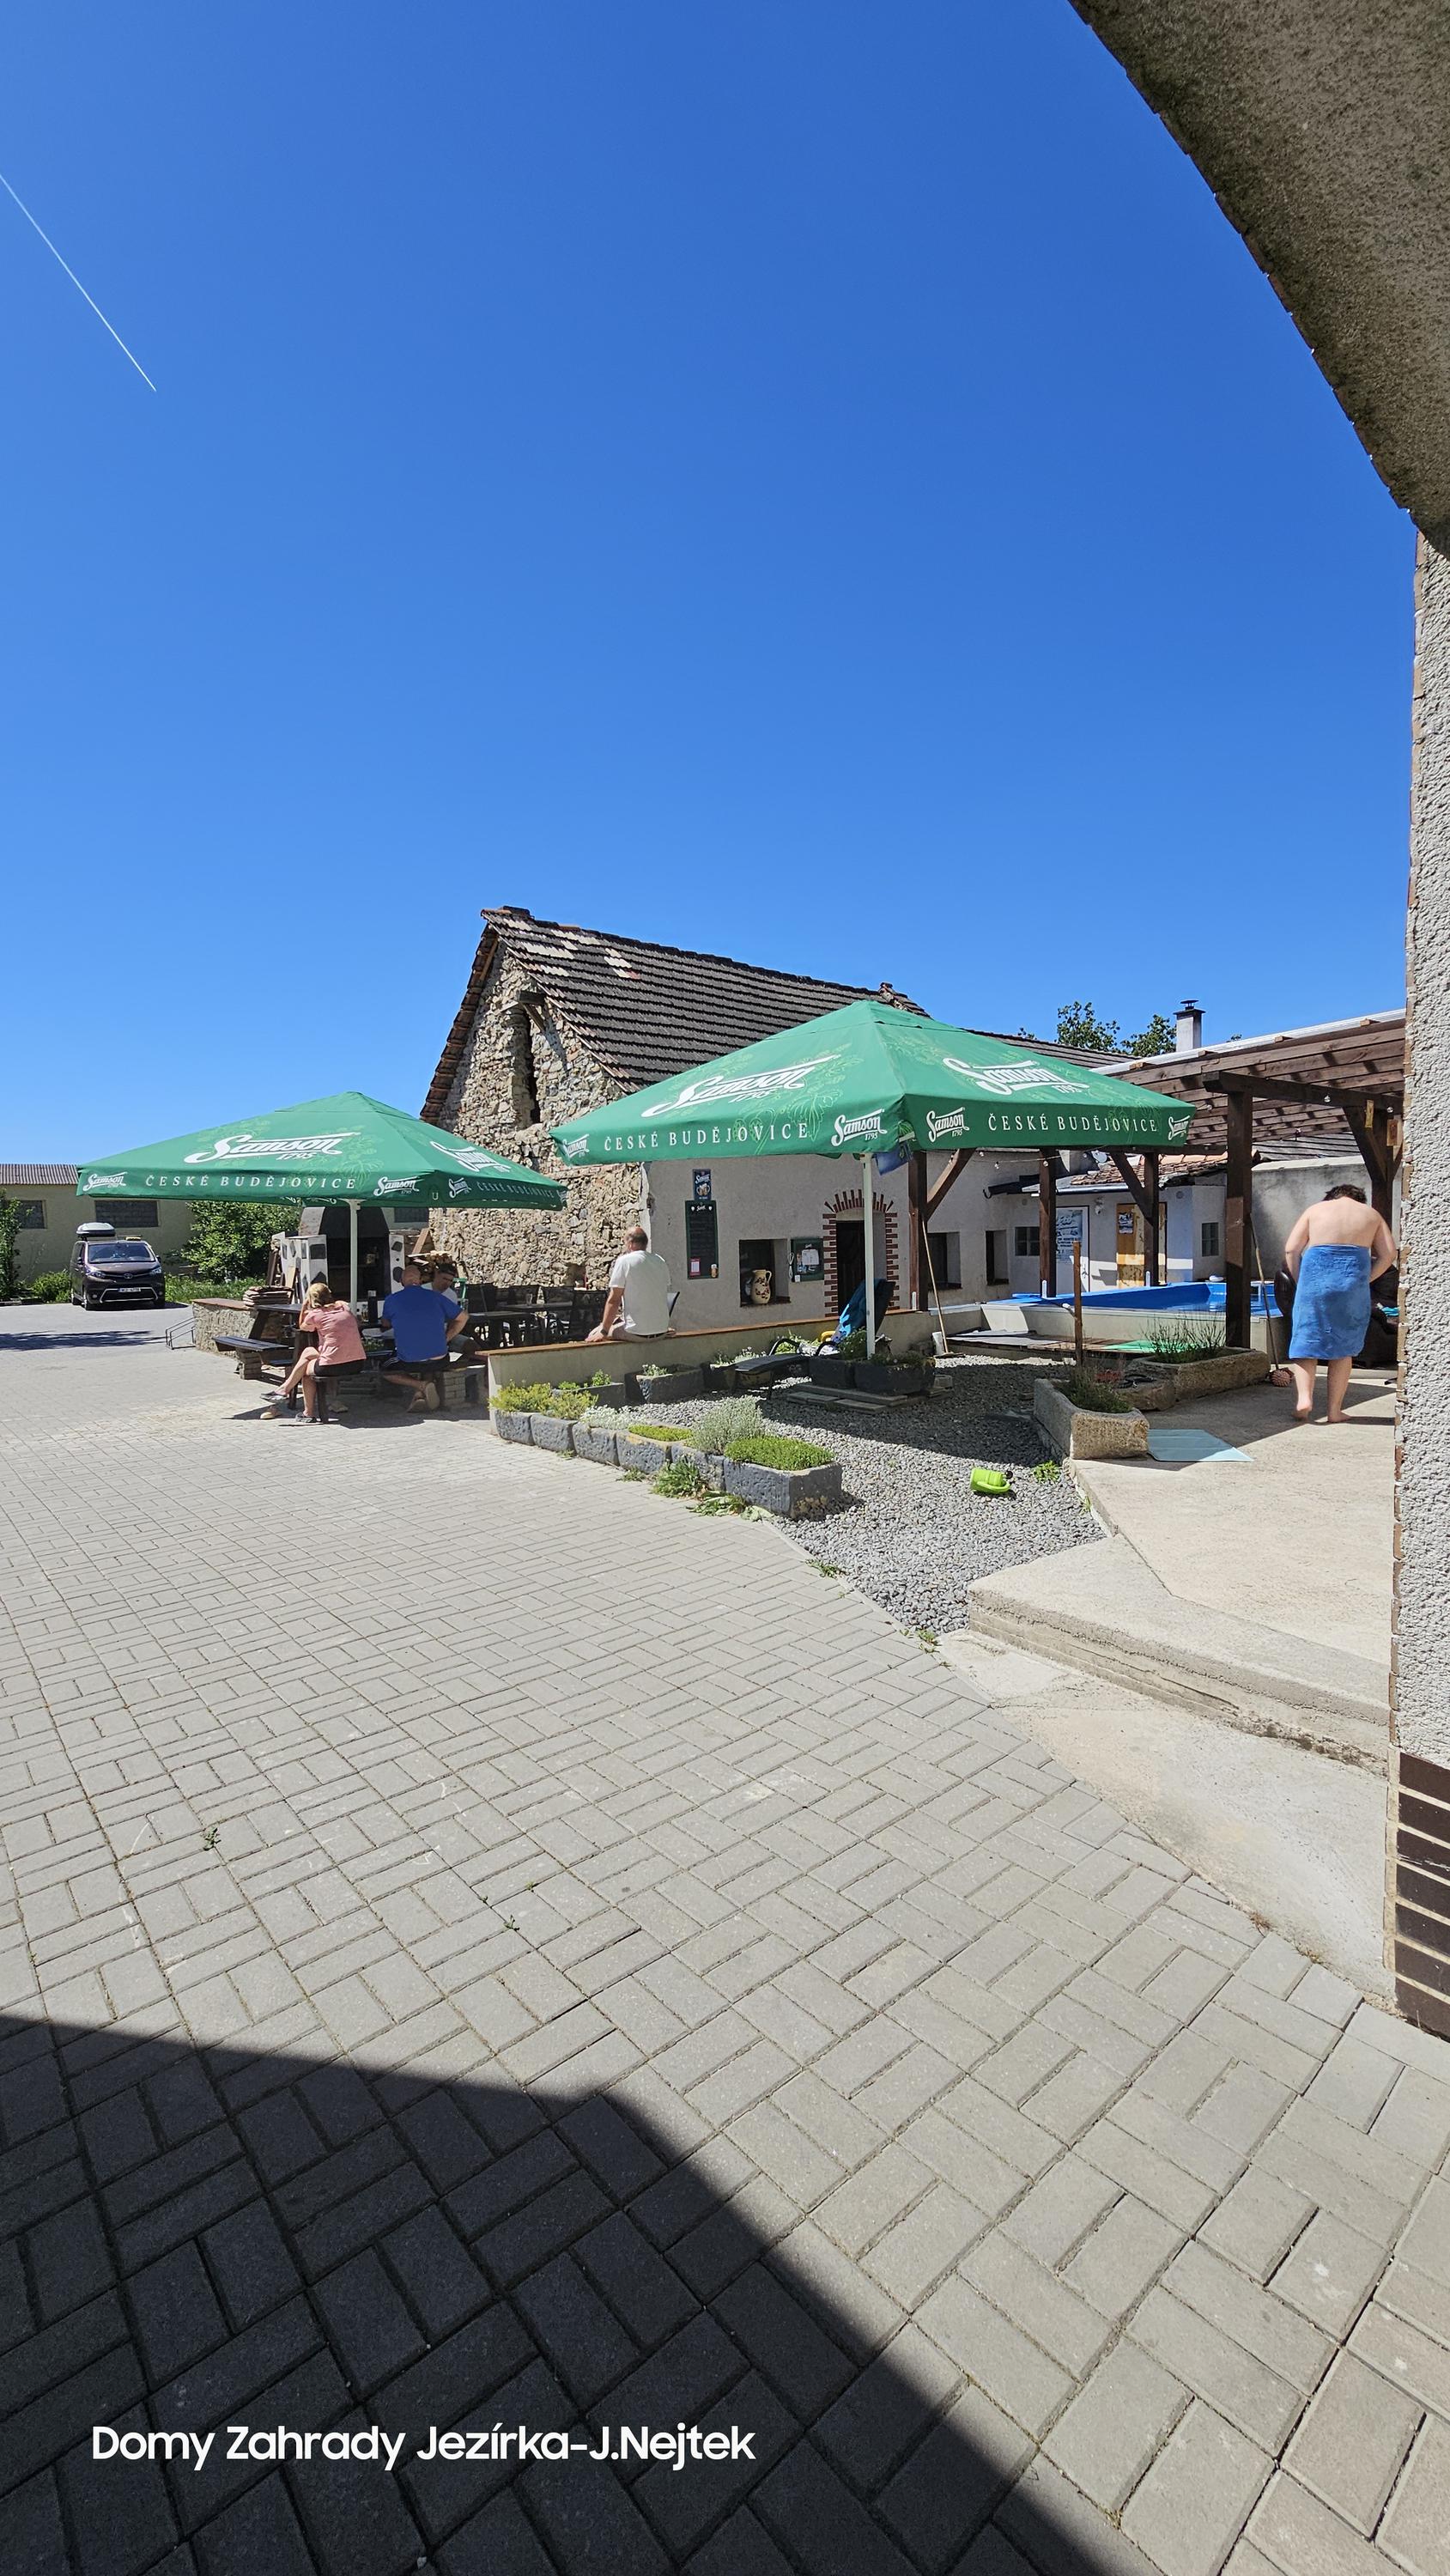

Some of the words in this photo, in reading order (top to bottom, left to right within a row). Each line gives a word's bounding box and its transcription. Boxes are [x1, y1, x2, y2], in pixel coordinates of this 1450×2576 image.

[641, 1054, 841, 1117] Samson
[943, 1058, 1091, 1096] Samson
[728, 1088, 778, 1103] 1795
[830, 1108, 888, 1146] Samson
[925, 1106, 970, 1143] Samson
[988, 1113, 1048, 1132] ČESKÉ
[1058, 1115, 1157, 1133] BUDĚJOVICE
[184, 1132, 361, 1163] Samson
[604, 1133, 658, 1152] ČESKÉ
[670, 1121, 809, 1148] BUDĚJOVICE
[865, 1133, 878, 1141] 1795
[276, 1151, 318, 1160] 1795
[145, 1174, 209, 1187] ČESKÉ
[220, 1175, 356, 1189] BUDĚJOVICE
[373, 1176, 420, 1196] Samson
